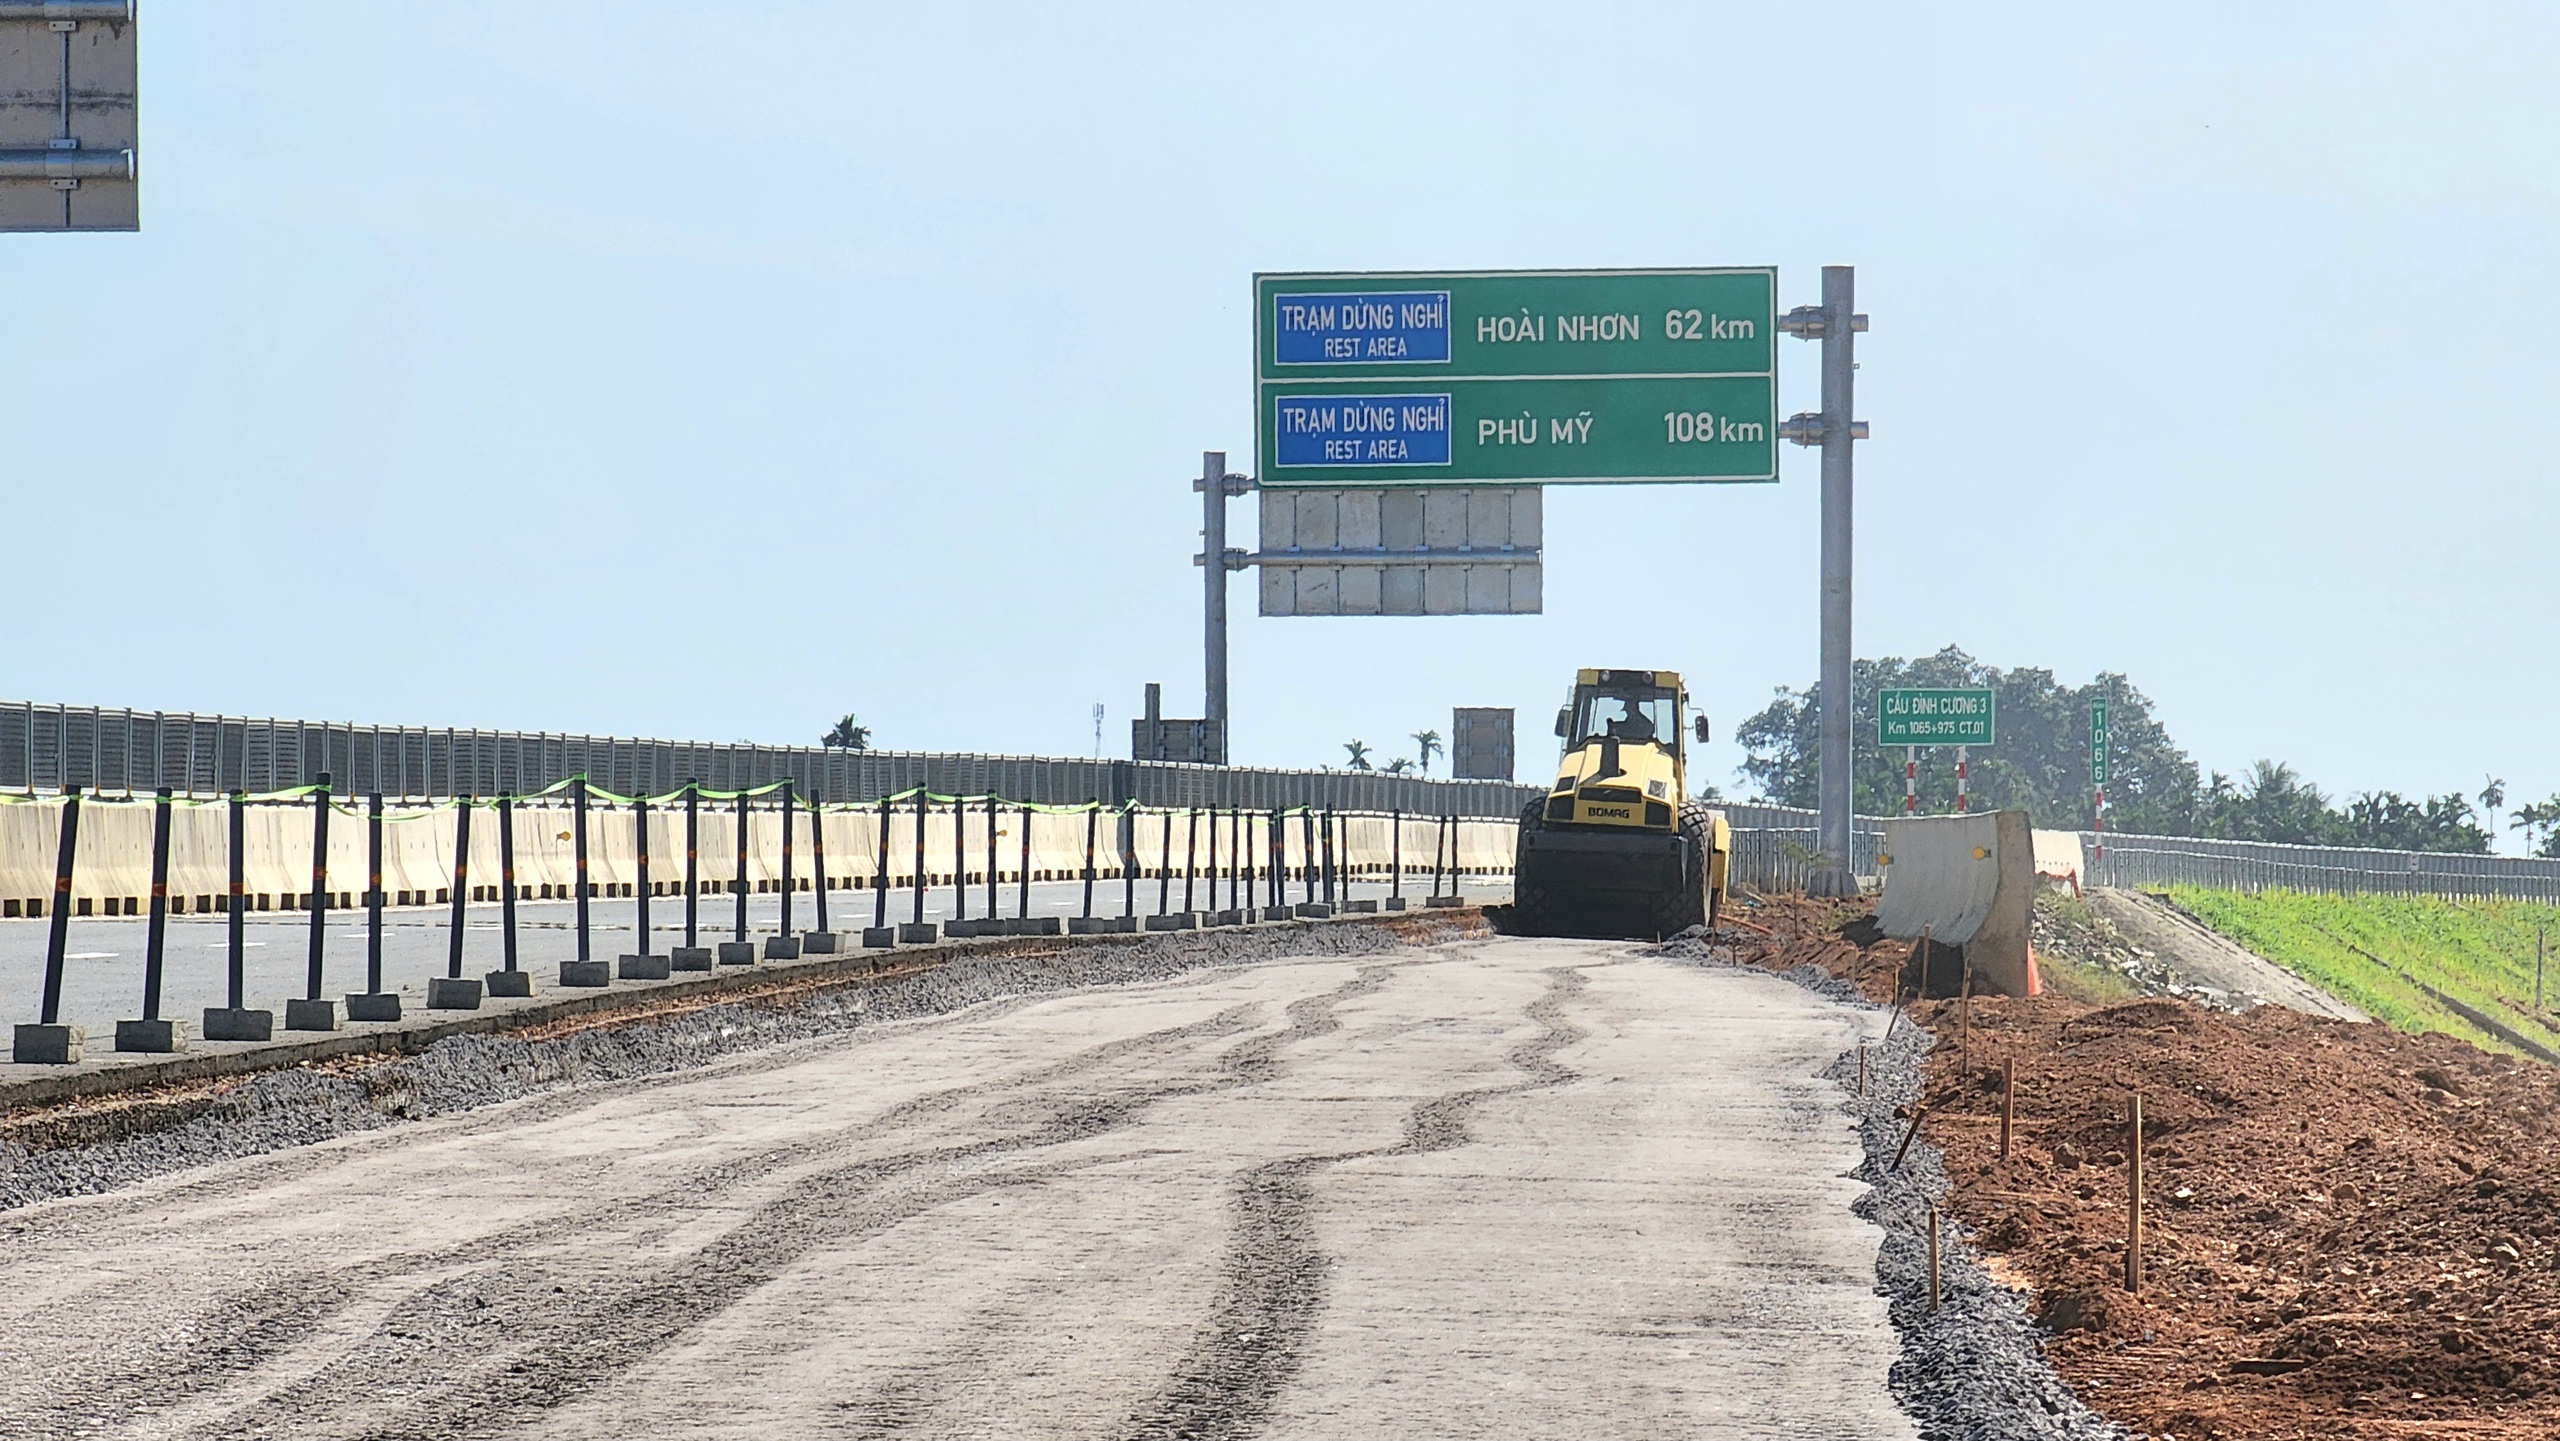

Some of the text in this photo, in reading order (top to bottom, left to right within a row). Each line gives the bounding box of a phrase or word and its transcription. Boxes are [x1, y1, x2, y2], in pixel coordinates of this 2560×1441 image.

[1282, 294, 1444, 336] TRẠM DỪNG NGHỈ
[1477, 307, 1754, 342] HOÀI NHƠN 62 km
[1325, 336, 1407, 358] REST AREA
[1283, 398, 1445, 439] TRẠM DỪNG NGHỈ
[1478, 410, 1764, 445] PHÙ MỸ 108 km
[1325, 439, 1408, 460] REST AREA
[1912, 692, 1938, 715] ĐÌNH
[1980, 697, 1987, 714] 3
[1888, 721, 1985, 735] Km 1065+975 CT.01
[1588, 807, 1630, 819] BOMAG
